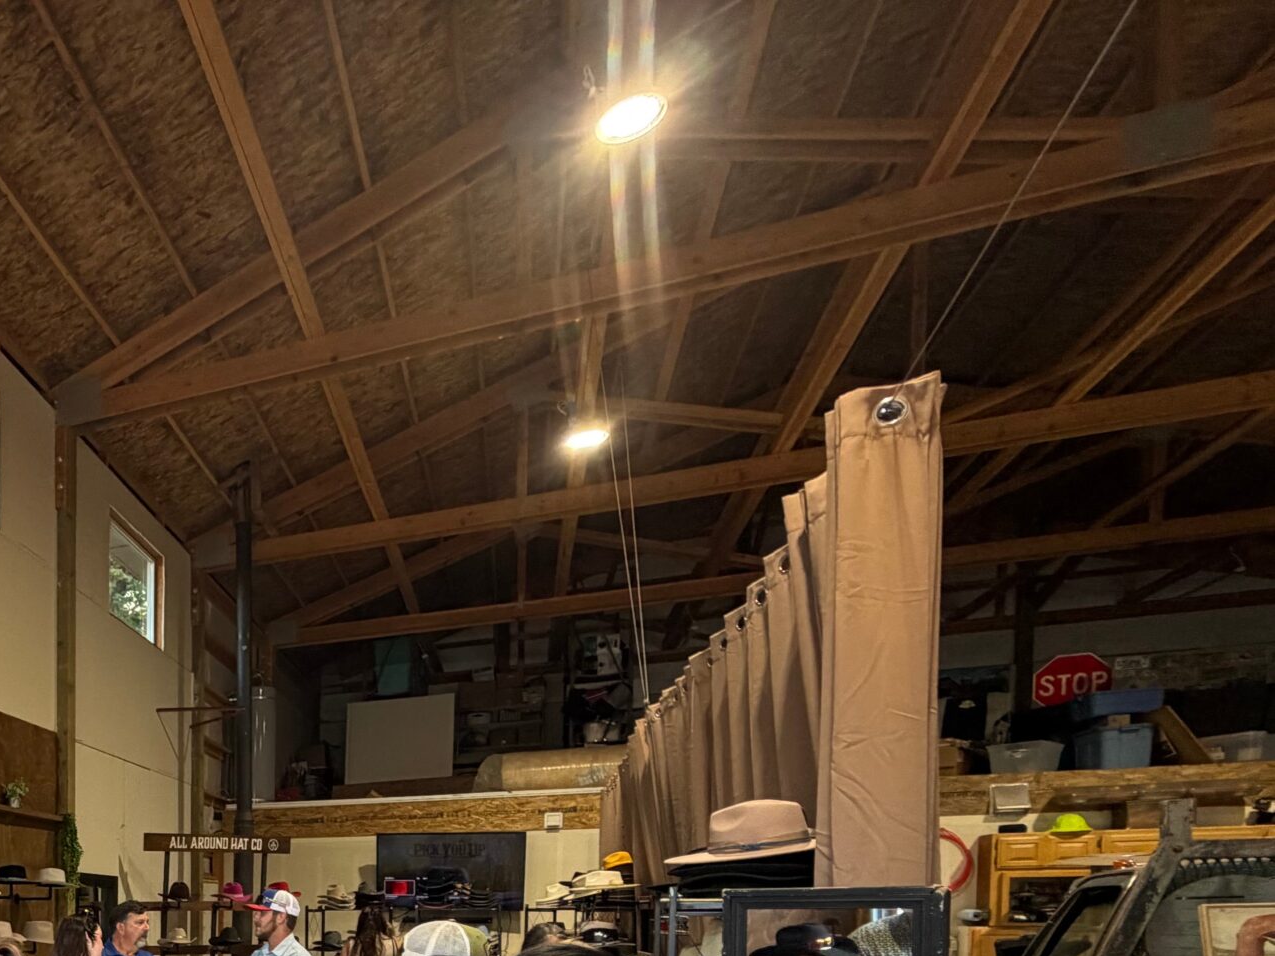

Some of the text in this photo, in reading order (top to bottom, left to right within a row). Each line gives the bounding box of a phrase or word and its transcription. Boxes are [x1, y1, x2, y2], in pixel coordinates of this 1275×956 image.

[1039, 671, 1108, 697] STOP
[169, 836, 263, 850] ALL AROUND HAT CO
